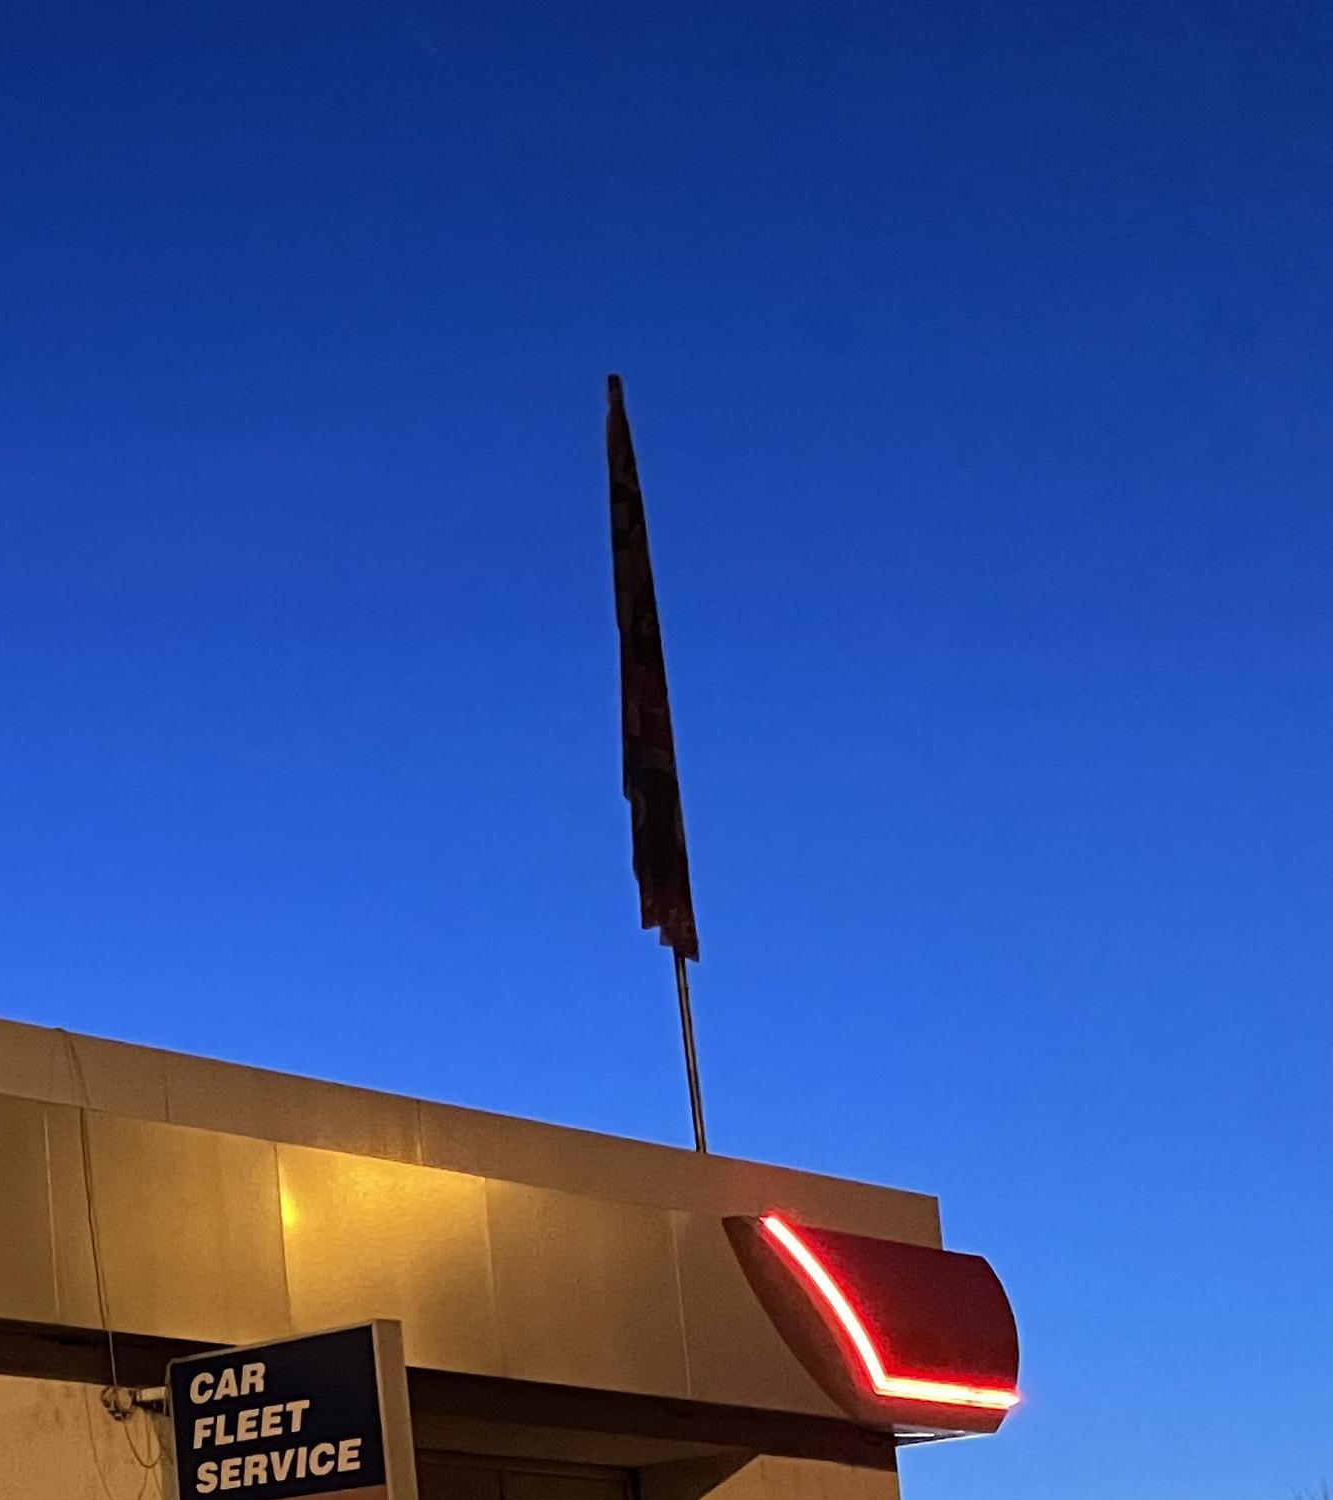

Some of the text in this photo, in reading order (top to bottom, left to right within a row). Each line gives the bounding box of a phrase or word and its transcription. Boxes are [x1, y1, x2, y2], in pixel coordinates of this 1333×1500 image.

[189, 1362, 266, 1404] CAR
[193, 1400, 311, 1449] FLEET
[196, 1437, 362, 1494] SERVICE
